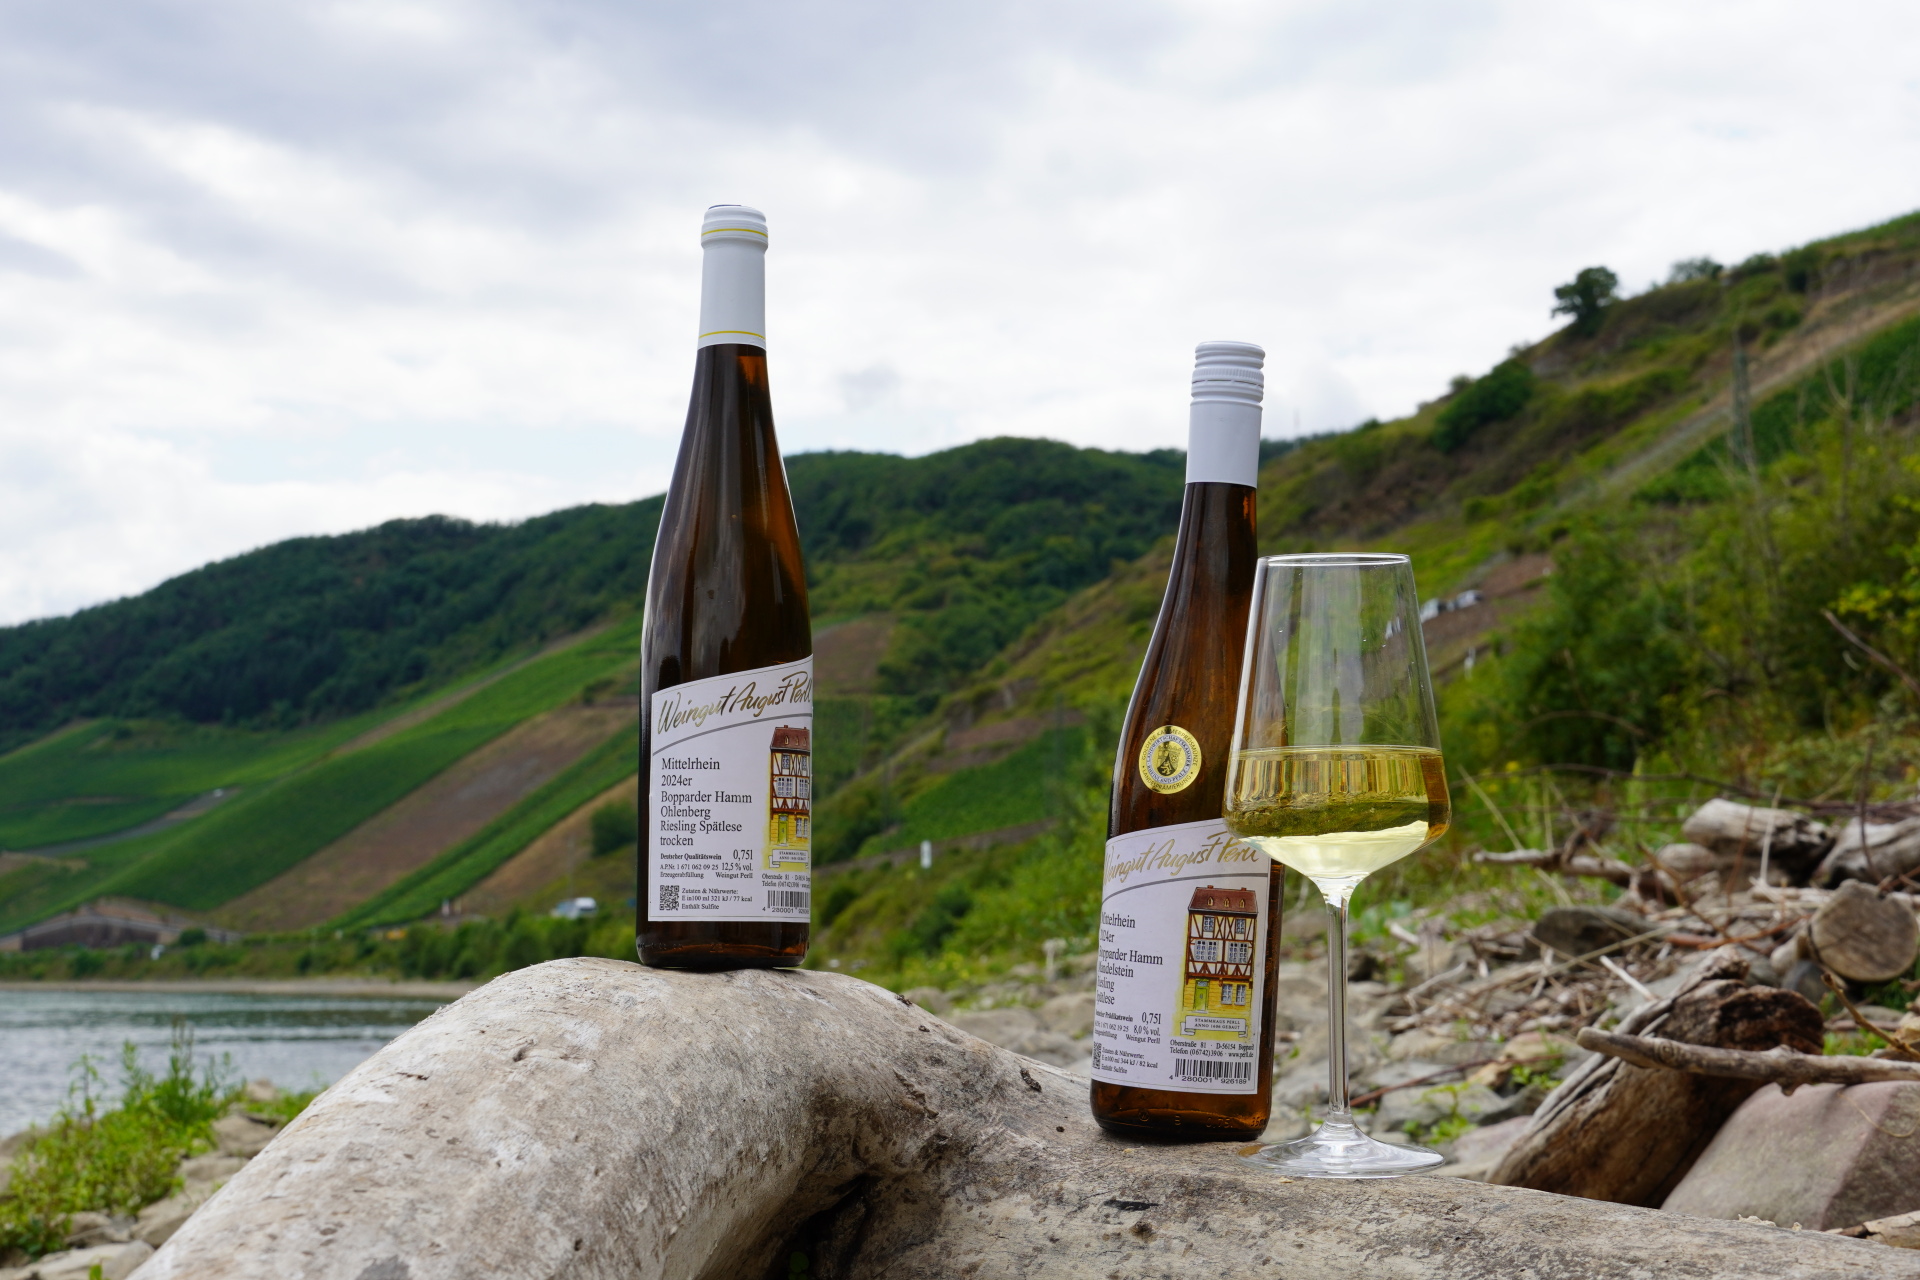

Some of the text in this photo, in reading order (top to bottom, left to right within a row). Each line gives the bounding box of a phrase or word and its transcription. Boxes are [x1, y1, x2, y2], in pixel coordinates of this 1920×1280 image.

[658, 685, 736, 734] Weingut
[729, 680, 792, 718] August
[661, 757, 720, 770] Mittelrhein
[661, 774, 692, 786] 2024er
[661, 790, 752, 805] Bopparder Hamm
[660, 806, 712, 820] Ohlenberg
[660, 820, 742, 834] Riesling Spätlese
[660, 834, 694, 846] trocken
[684, 853, 722, 861] Qualitätswein
[732, 849, 753, 861] 0,75l
[1146, 837, 1223, 876] August
[722, 862, 734, 872] 12,5
[742, 863, 753, 871] vol.
[1129, 950, 1163, 965] Hamm
[1142, 1012, 1161, 1025] 0,75l
[1134, 1024, 1142, 1035] 8,0
[1150, 1028, 1160, 1036] vol.
[1126, 1034, 1146, 1043] Weingut
[1147, 1036, 1160, 1044] Perll
[1170, 1039, 1197, 1048] Oberstraße
[1170, 1047, 1188, 1055] Telefon
